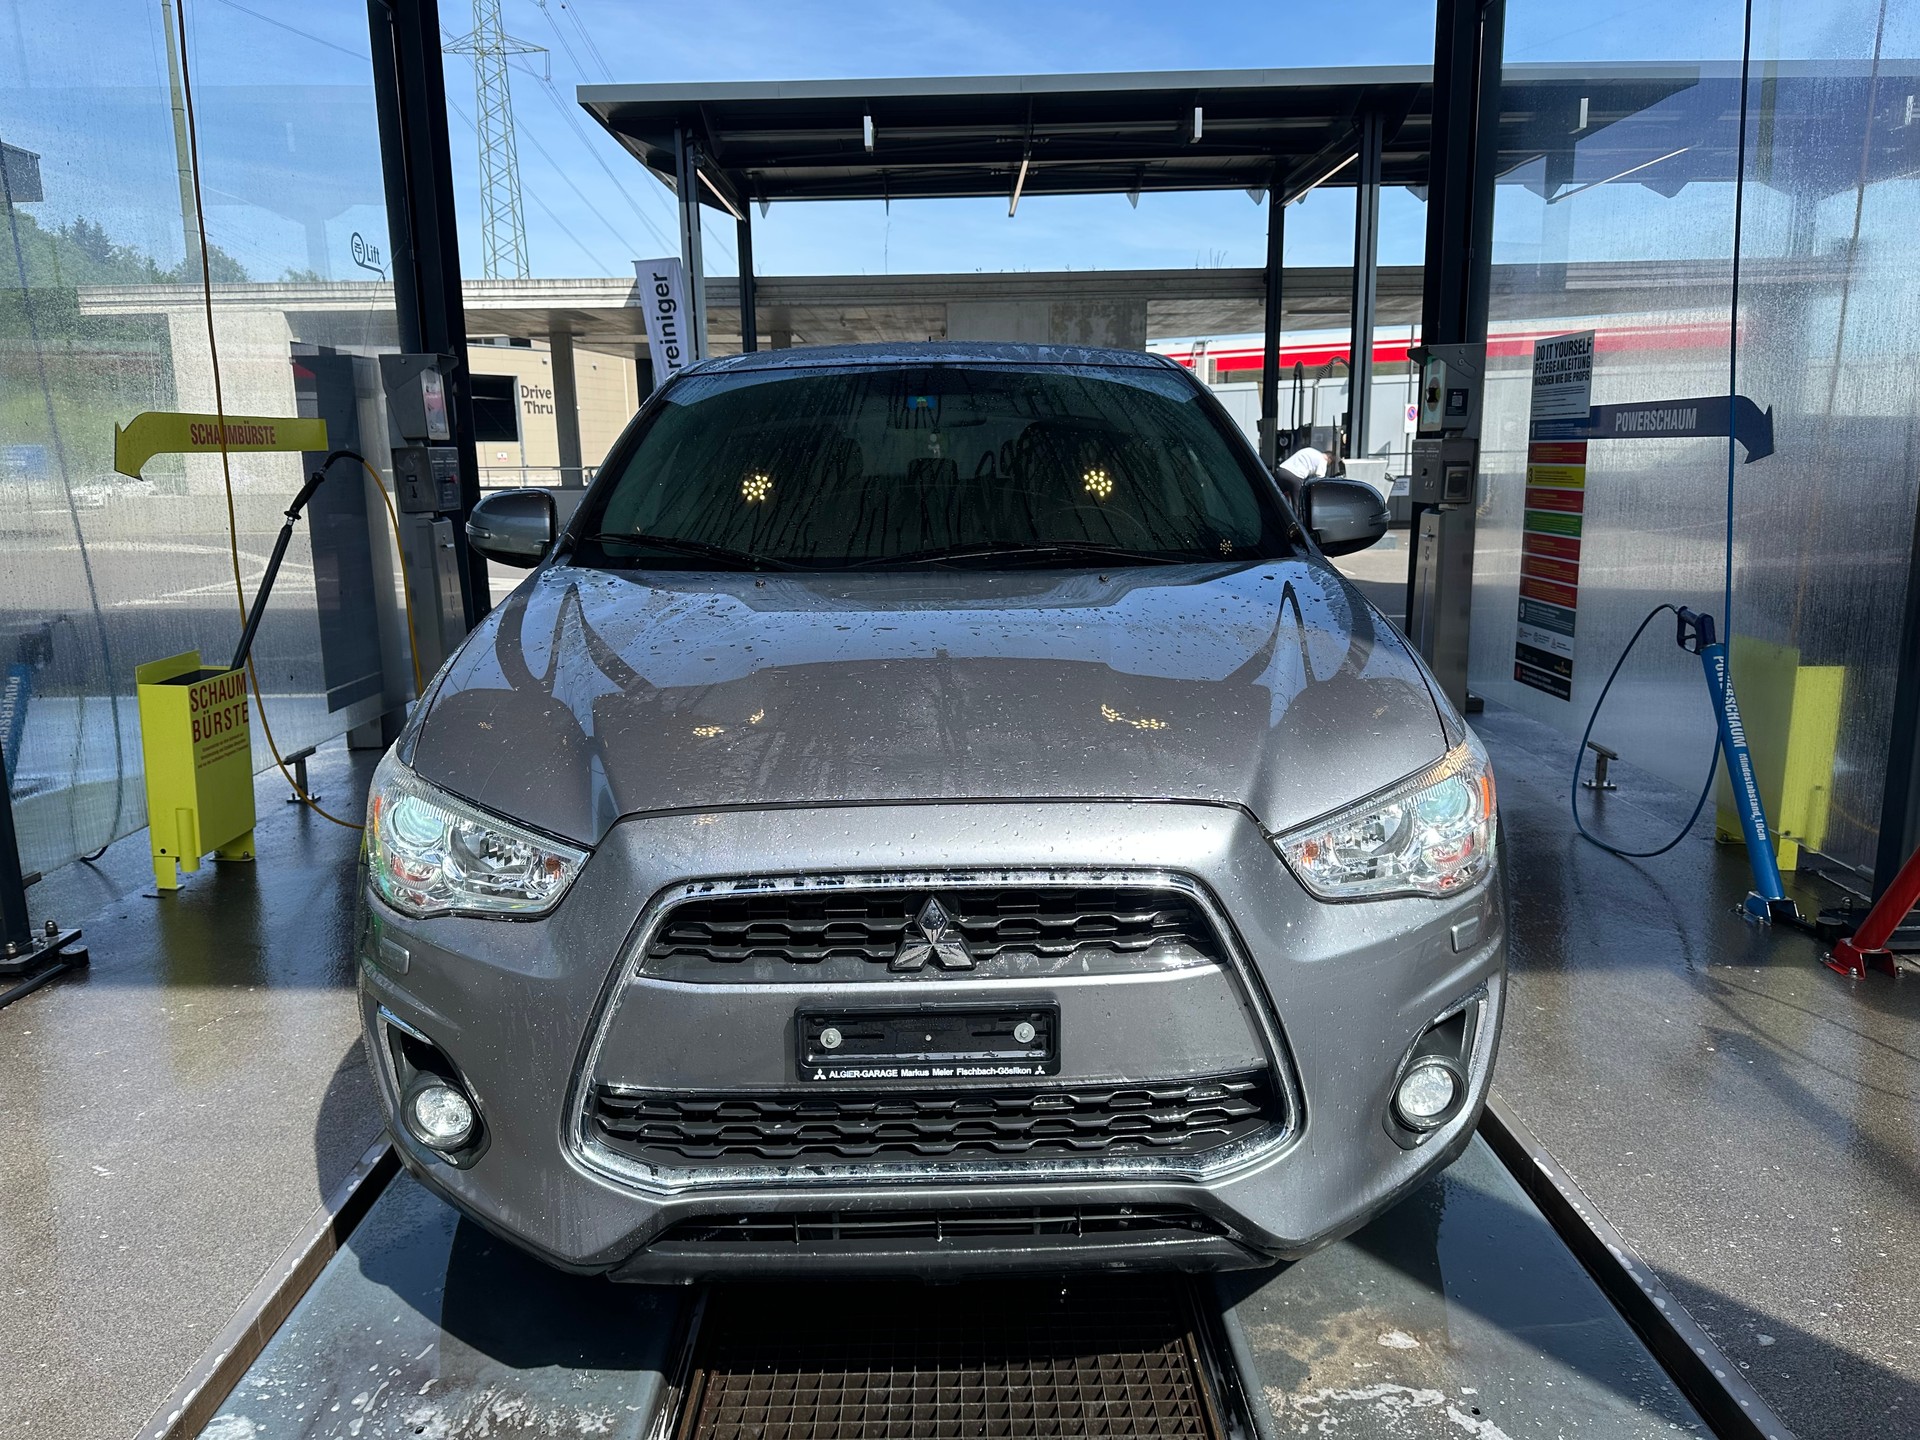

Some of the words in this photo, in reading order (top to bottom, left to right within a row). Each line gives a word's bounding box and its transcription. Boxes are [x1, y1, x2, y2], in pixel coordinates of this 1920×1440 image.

[366, 243, 381, 265] Lift
[1535, 345, 1546, 362] DO
[1546, 343, 1554, 360] IT
[1554, 336, 1592, 359] YOURSELF
[1534, 355, 1591, 375] PFLEGEANLEITUNG
[1534, 374, 1555, 387] WASCHEN
[1555, 373, 1564, 384] WIE
[1564, 372, 1573, 383] DIE
[1573, 370, 1590, 382] PROFIS
[520, 384, 552, 399] Drive
[523, 400, 553, 415] Thru
[1615, 407, 1698, 432] POWERSCHAUM
[190, 420, 276, 446] SCHAUMBÜRSTE
[1528, 467, 1534, 484] 3
[190, 671, 248, 713] SCHAUM
[192, 701, 249, 744] BÜRSTE
[829, 1069, 898, 1079] ALGIER-GARAGE
[900, 1068, 930, 1077] Markus
[932, 1068, 954, 1076] Meier
